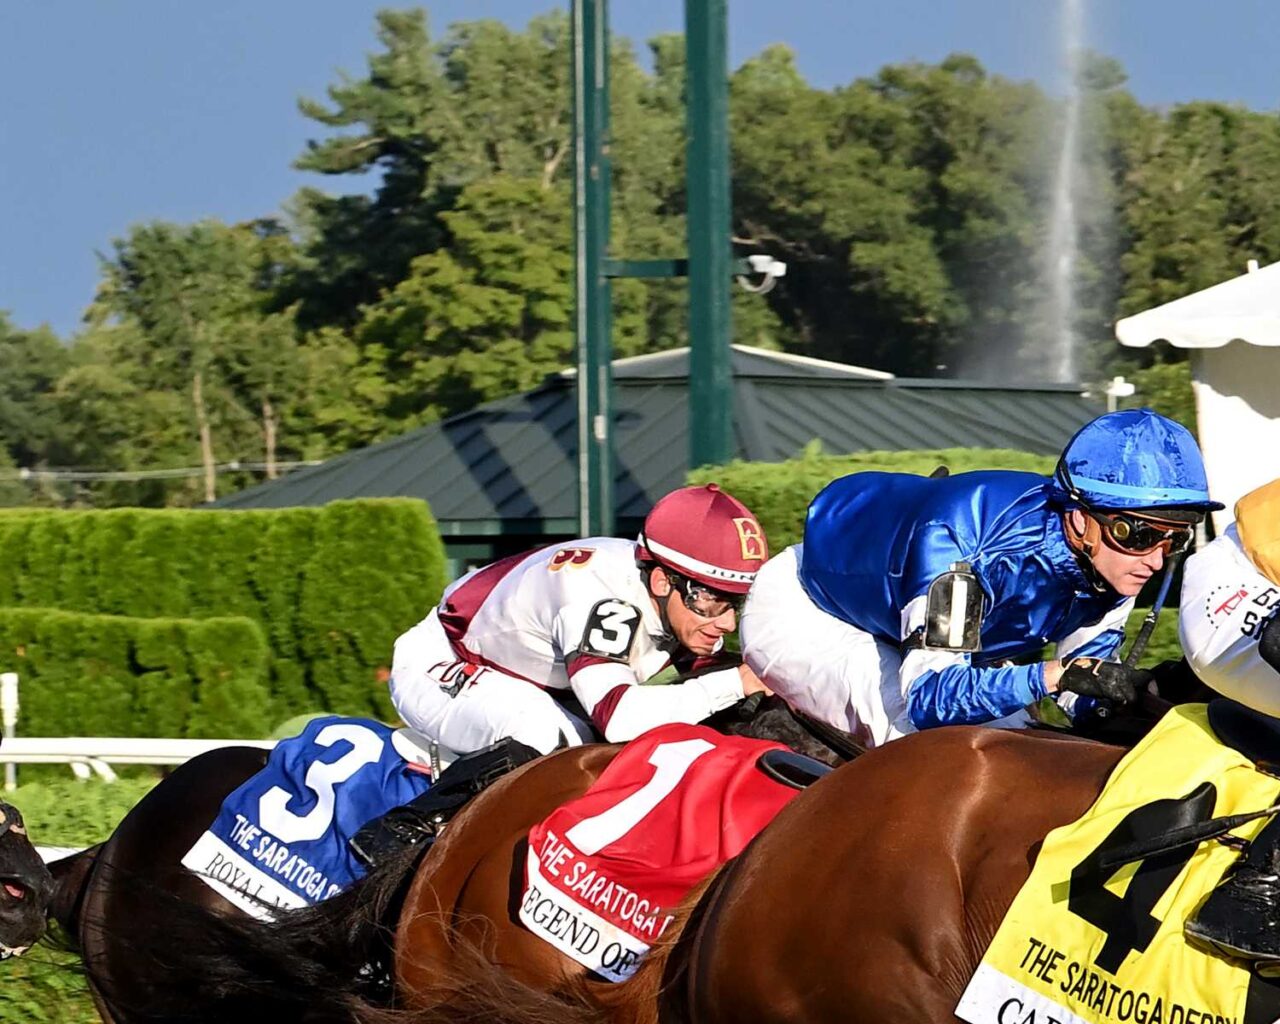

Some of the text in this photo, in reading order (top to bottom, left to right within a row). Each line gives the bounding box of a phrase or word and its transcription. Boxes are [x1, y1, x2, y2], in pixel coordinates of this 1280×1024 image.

[732, 516, 767, 561] B
[588, 600, 638, 656] 3
[259, 724, 383, 845] 3
[566, 737, 717, 857] 1
[229, 814, 328, 901] THE SARATOGA
[539, 831, 661, 936] THE SARATOGA
[1067, 781, 1218, 976] 4
[523, 885, 600, 955] EGEND
[600, 942, 641, 976] OF
[1020, 937, 1066, 985] THE
